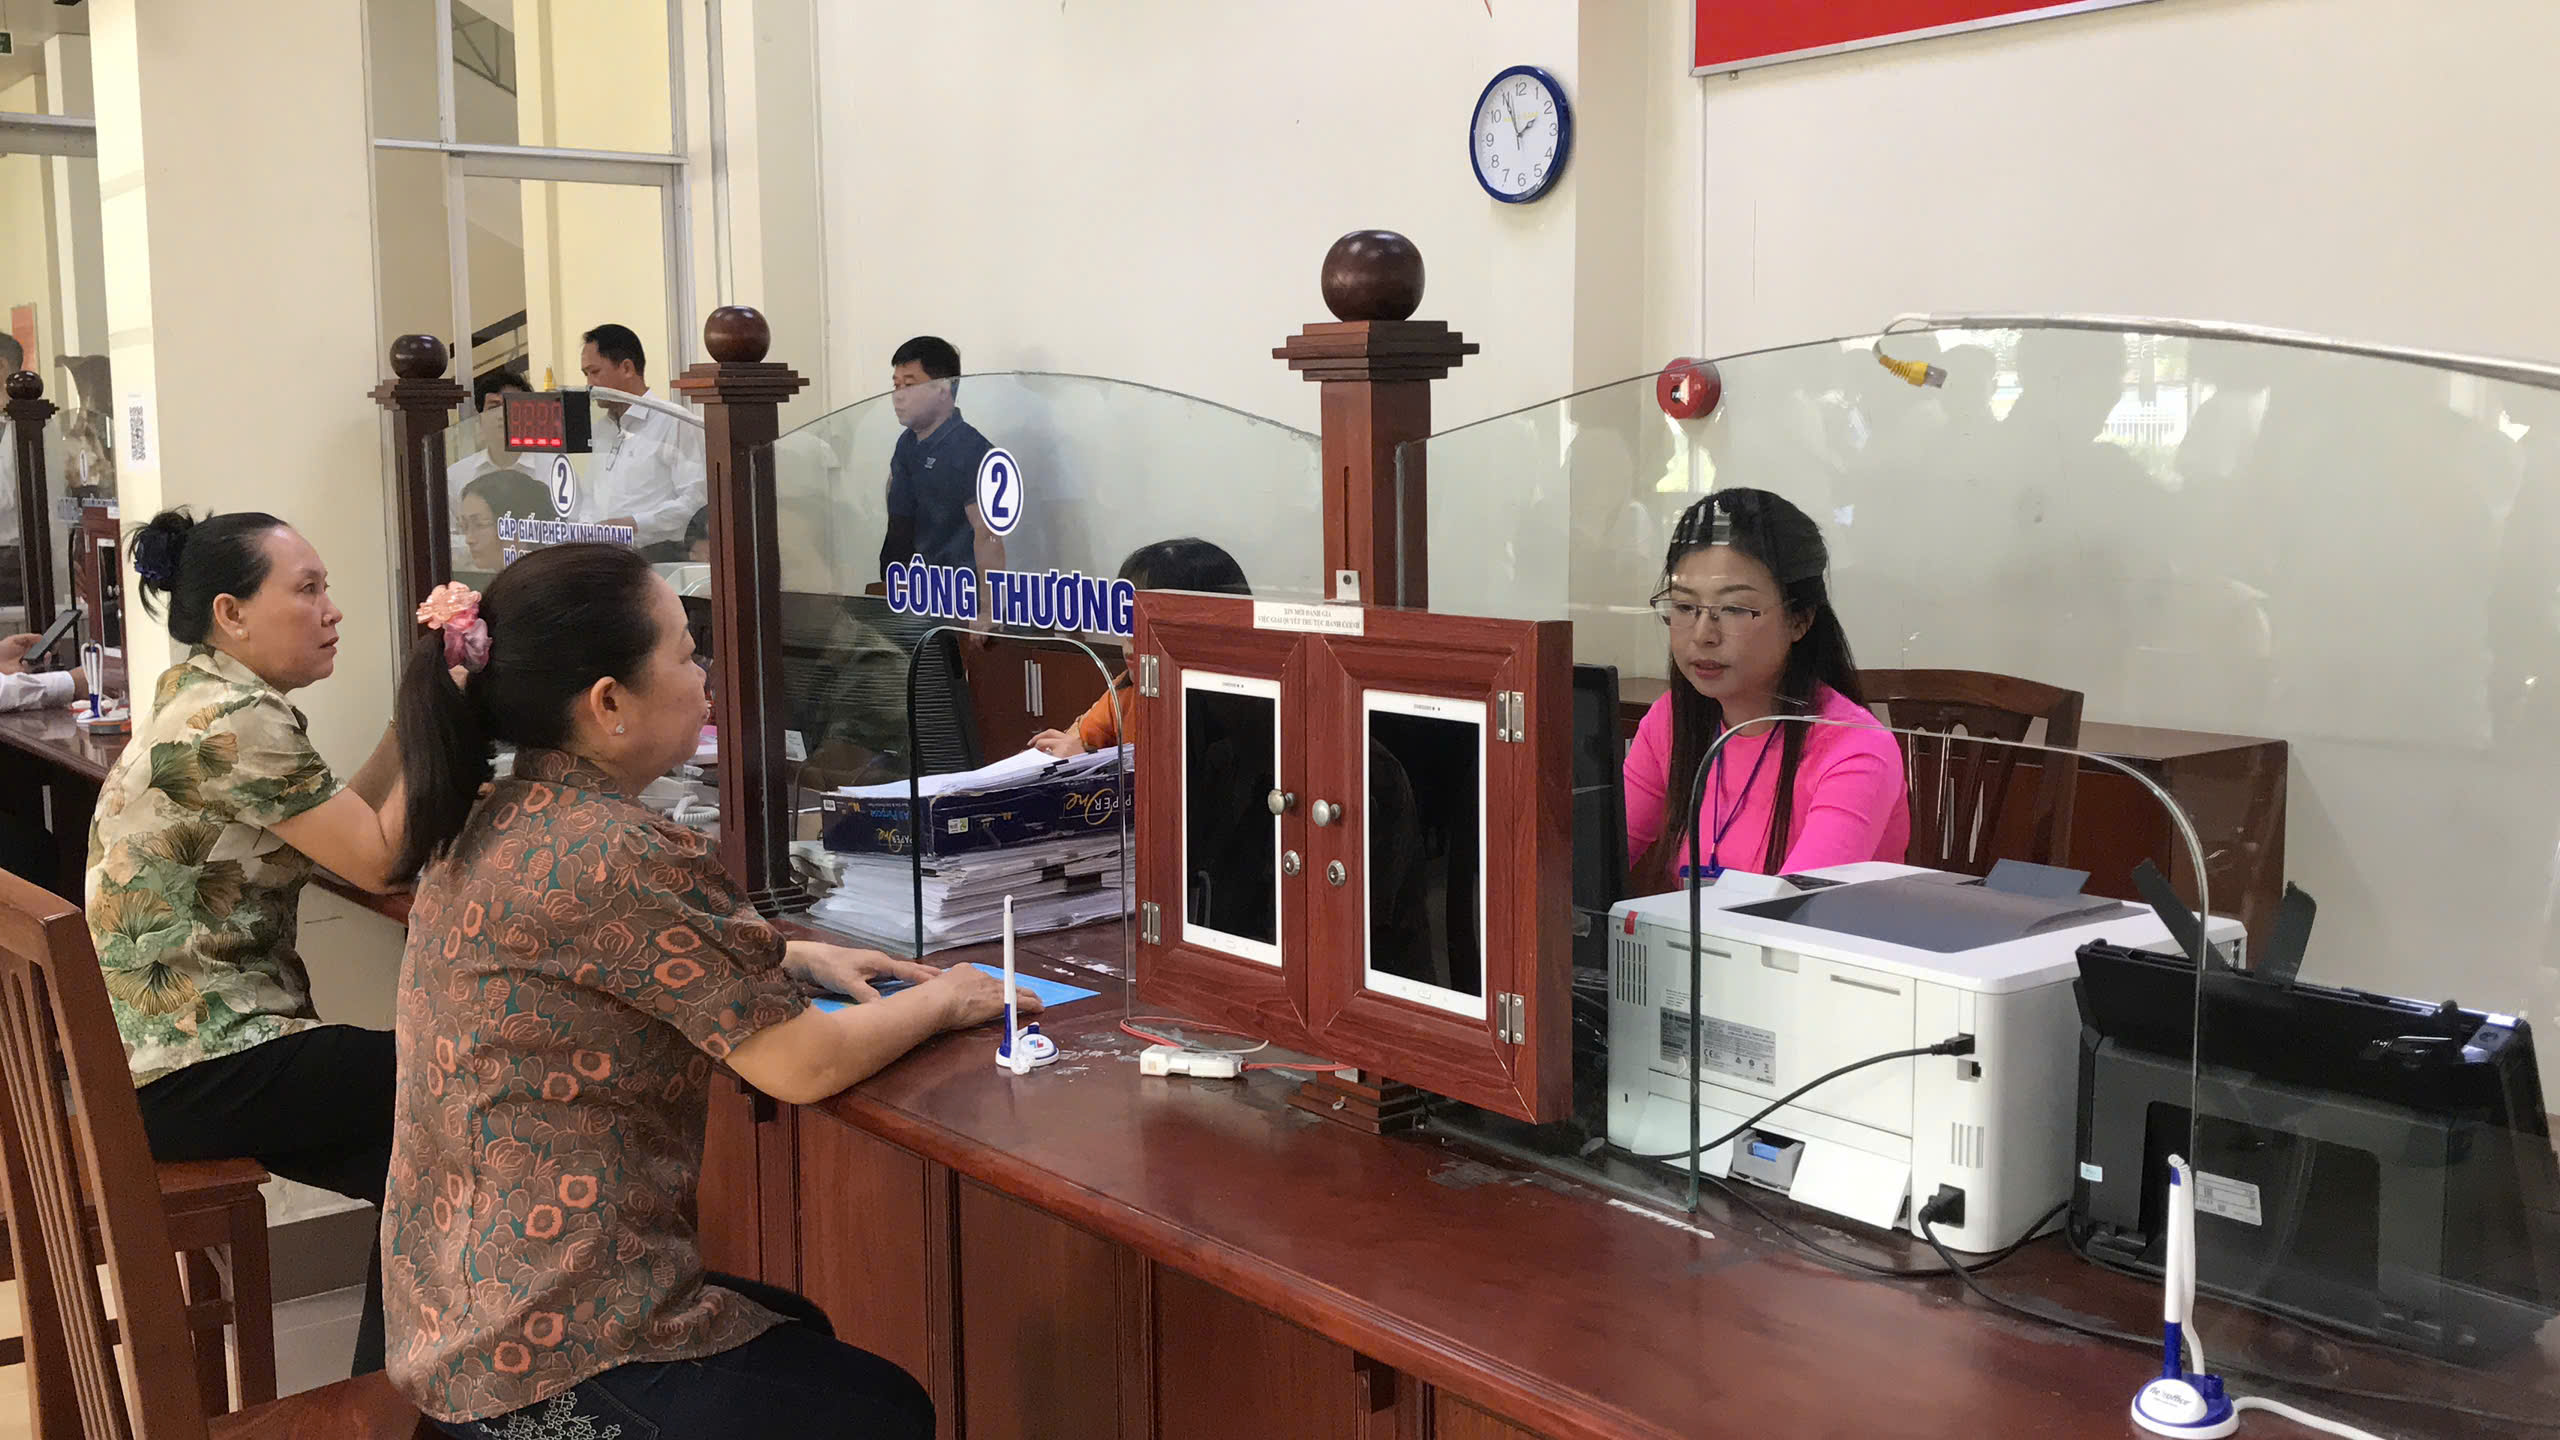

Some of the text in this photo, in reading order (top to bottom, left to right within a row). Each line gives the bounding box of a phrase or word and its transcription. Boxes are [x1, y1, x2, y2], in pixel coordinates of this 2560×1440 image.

[1515, 82, 1527, 97] 12
[1535, 87, 1539, 99] 1
[1543, 101, 1553, 115] 2
[1490, 110, 1502, 123] 10
[1549, 123, 1558, 136] 3
[1486, 133, 1494, 147] 9
[1545, 147, 1553, 159] 4
[1491, 154, 1500, 168] 8
[1503, 169, 1510, 183] 7
[1534, 164, 1543, 177] 5
[1518, 173, 1526, 187] 6
[557, 462, 568, 504] 2
[991, 463, 1009, 518] 2
[498, 511, 634, 545] CẤP GIẤY PHÉP KINH DOANH
[886, 554, 1134, 636] CÔNG THƯƠNG
[1064, 788, 1132, 825] PPEROne
